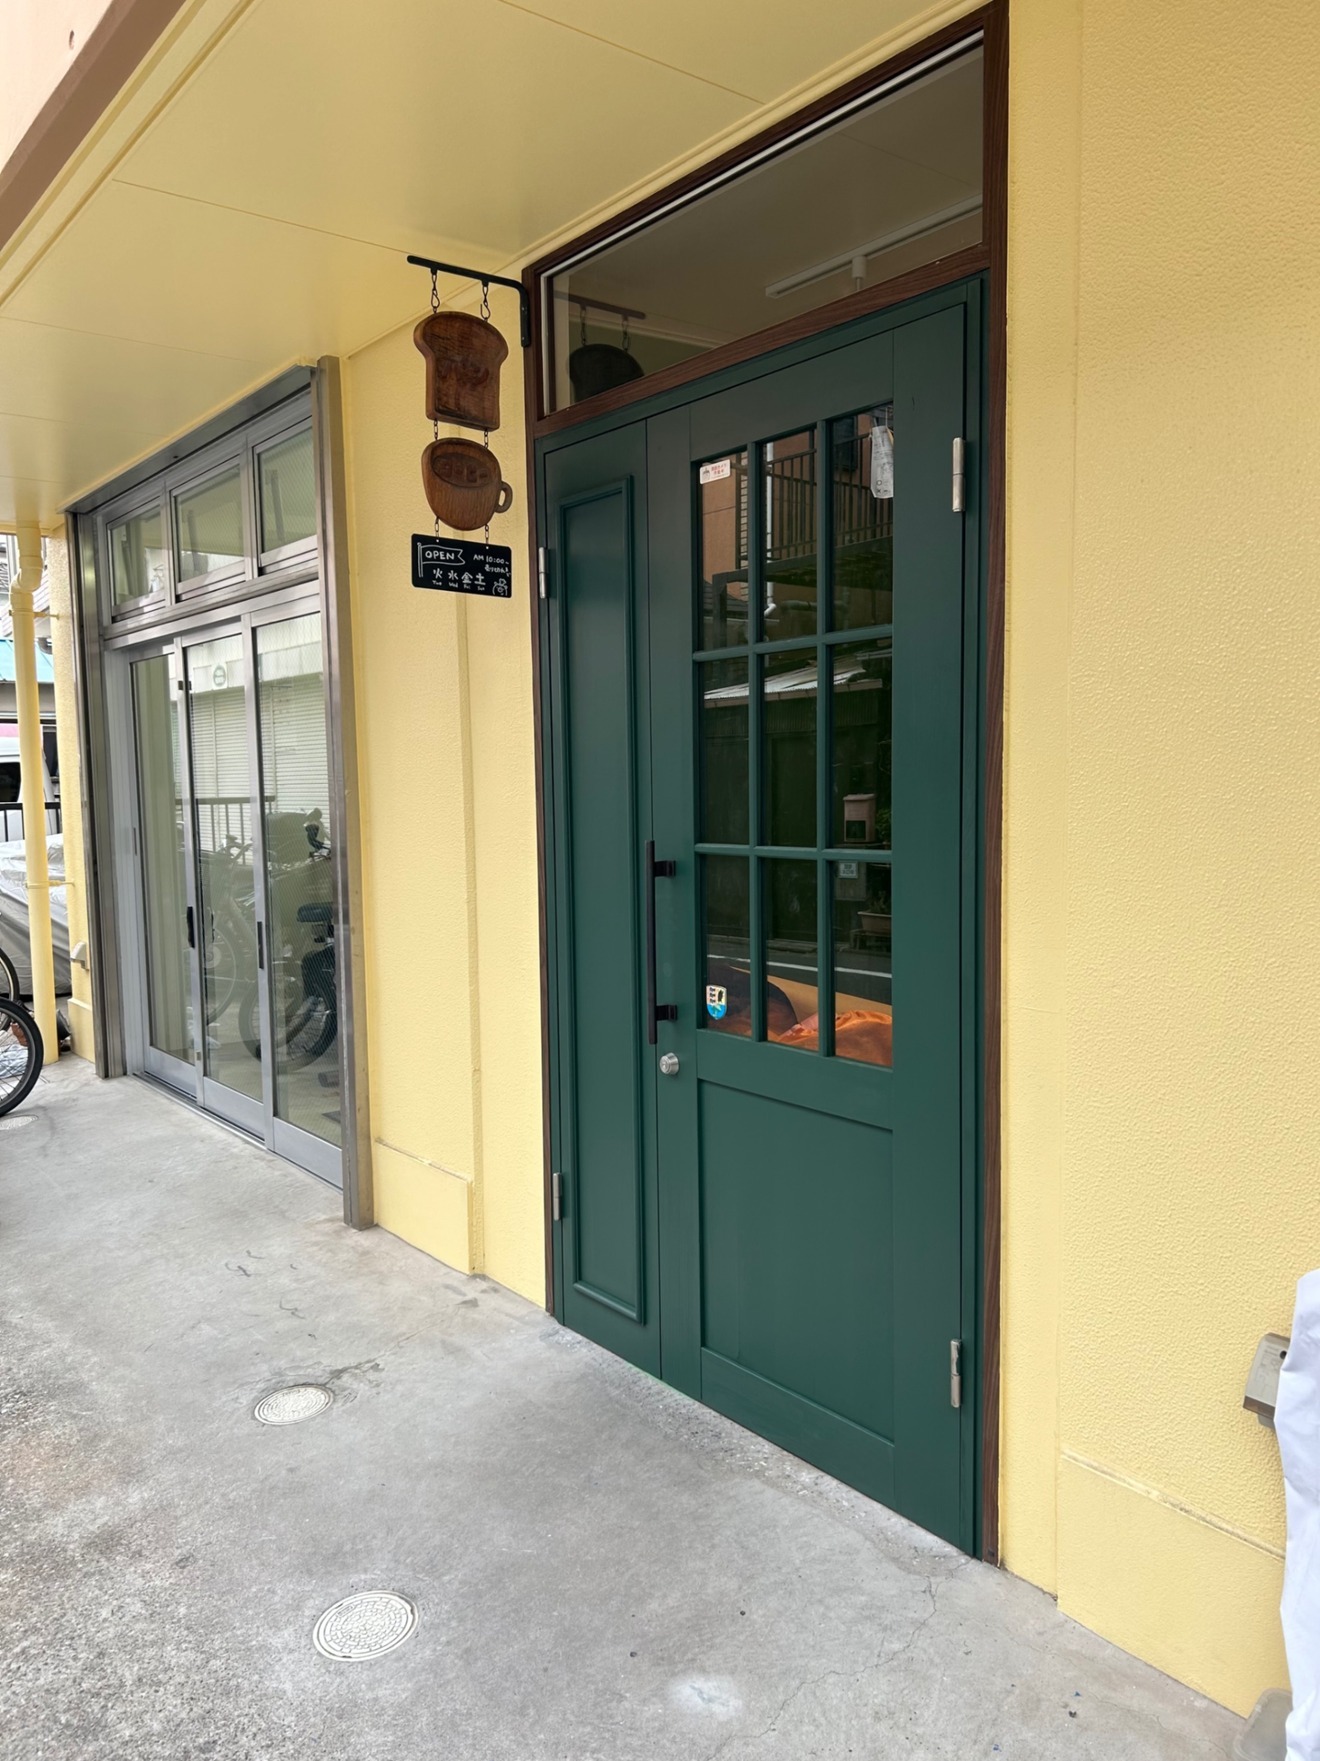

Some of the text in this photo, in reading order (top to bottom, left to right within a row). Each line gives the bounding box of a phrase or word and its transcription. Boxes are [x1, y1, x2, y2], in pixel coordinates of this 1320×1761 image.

[425, 550, 455, 560] OPEN
[433, 568, 486, 585] 火 水 金 土
